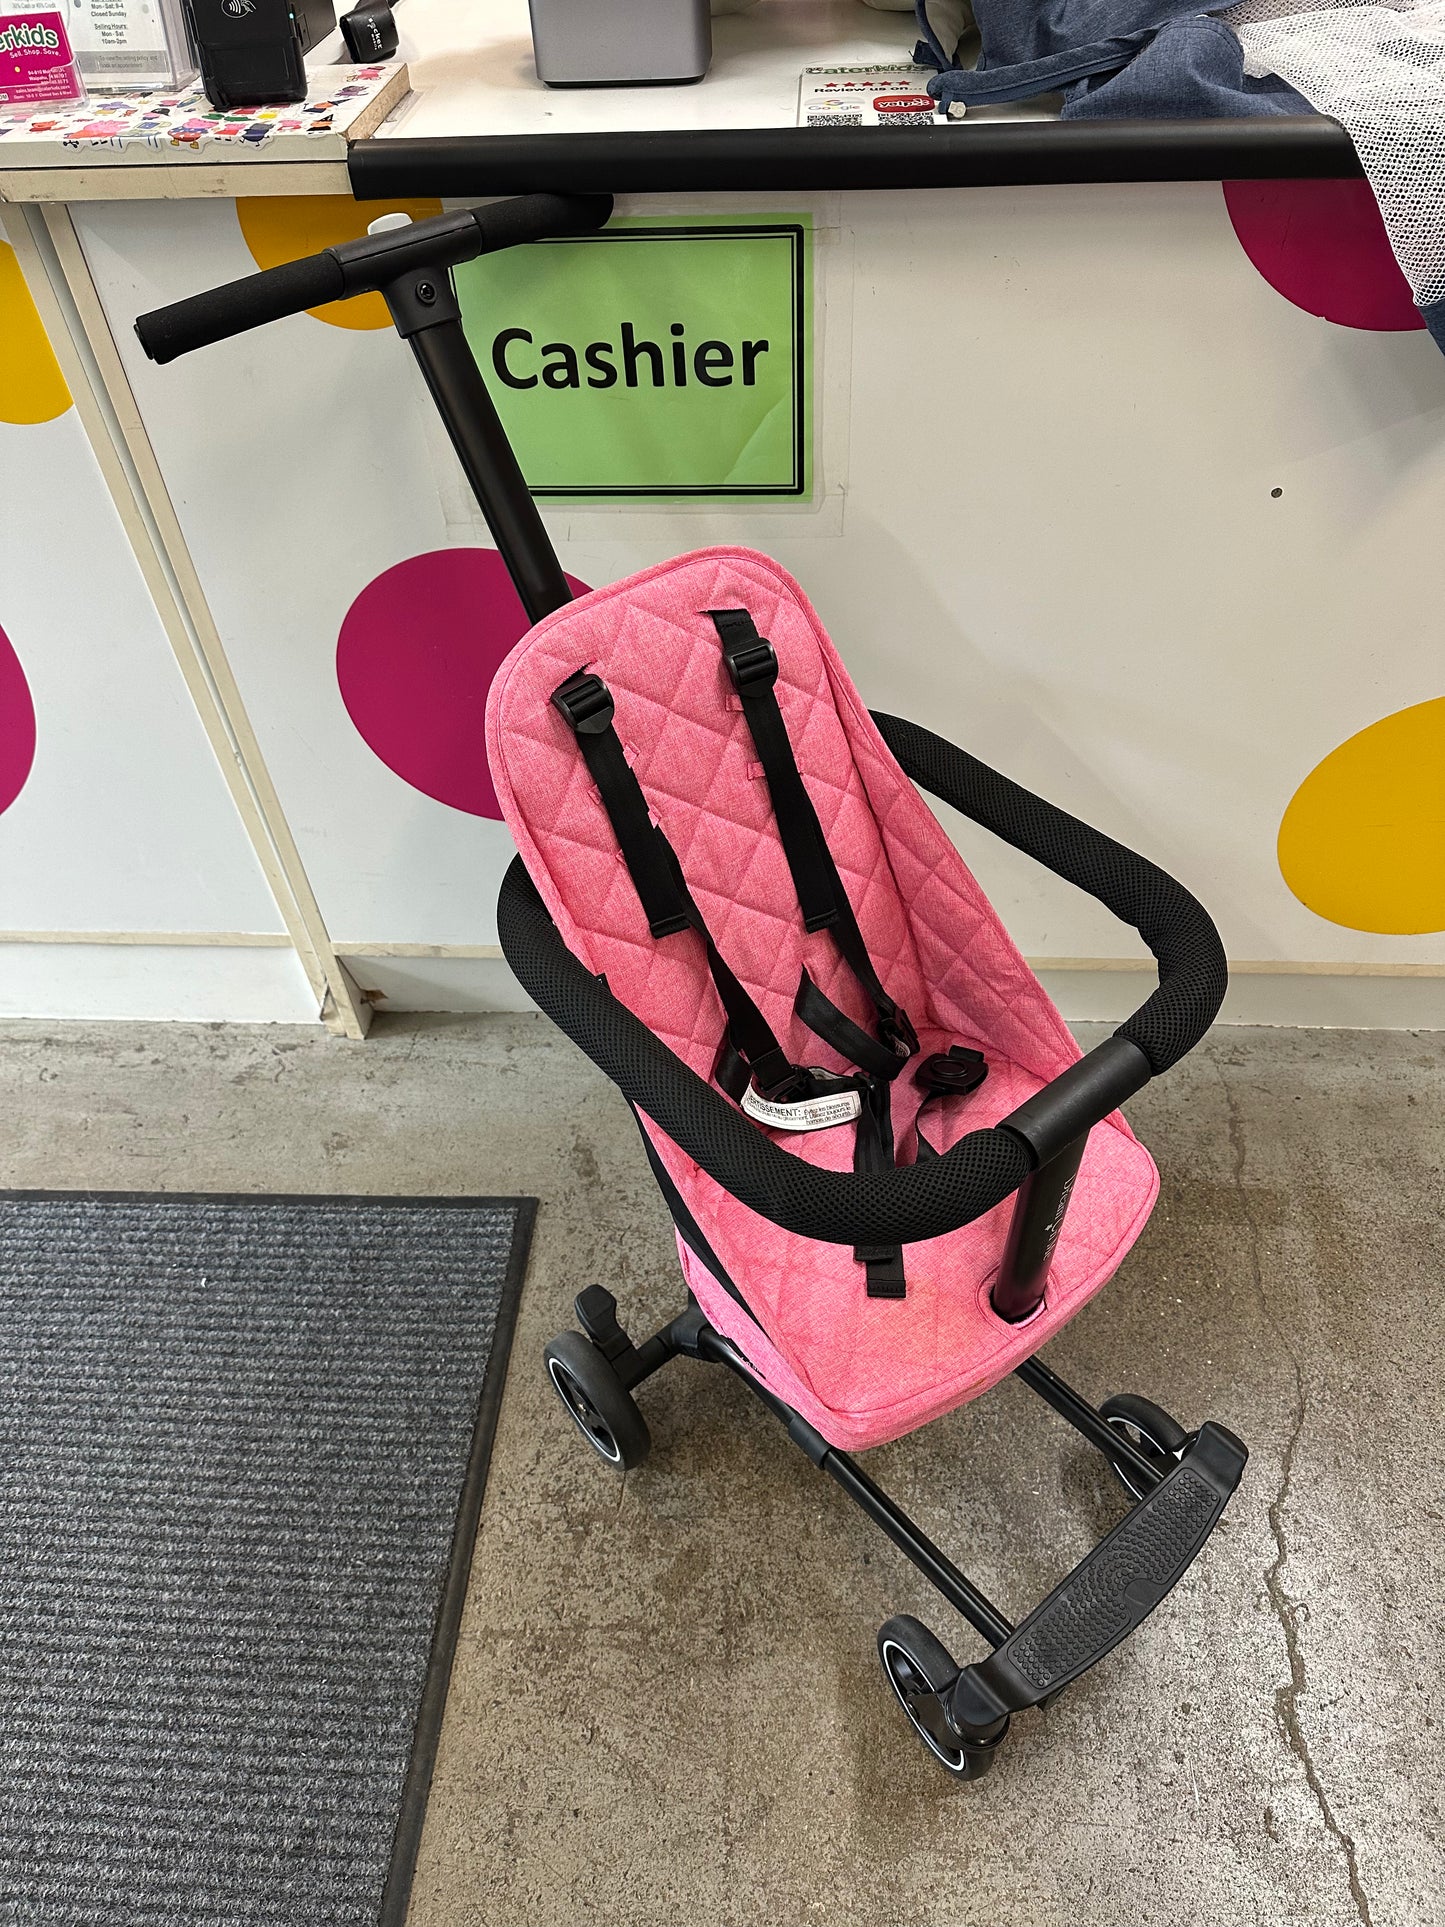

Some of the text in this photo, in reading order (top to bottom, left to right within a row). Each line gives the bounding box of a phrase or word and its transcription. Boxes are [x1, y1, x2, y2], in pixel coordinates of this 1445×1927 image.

[10, 48, 61, 59] Sell. Shop. Save.
[491, 321, 770, 390] Cashier
[1055, 1173, 1077, 1220] Dream
